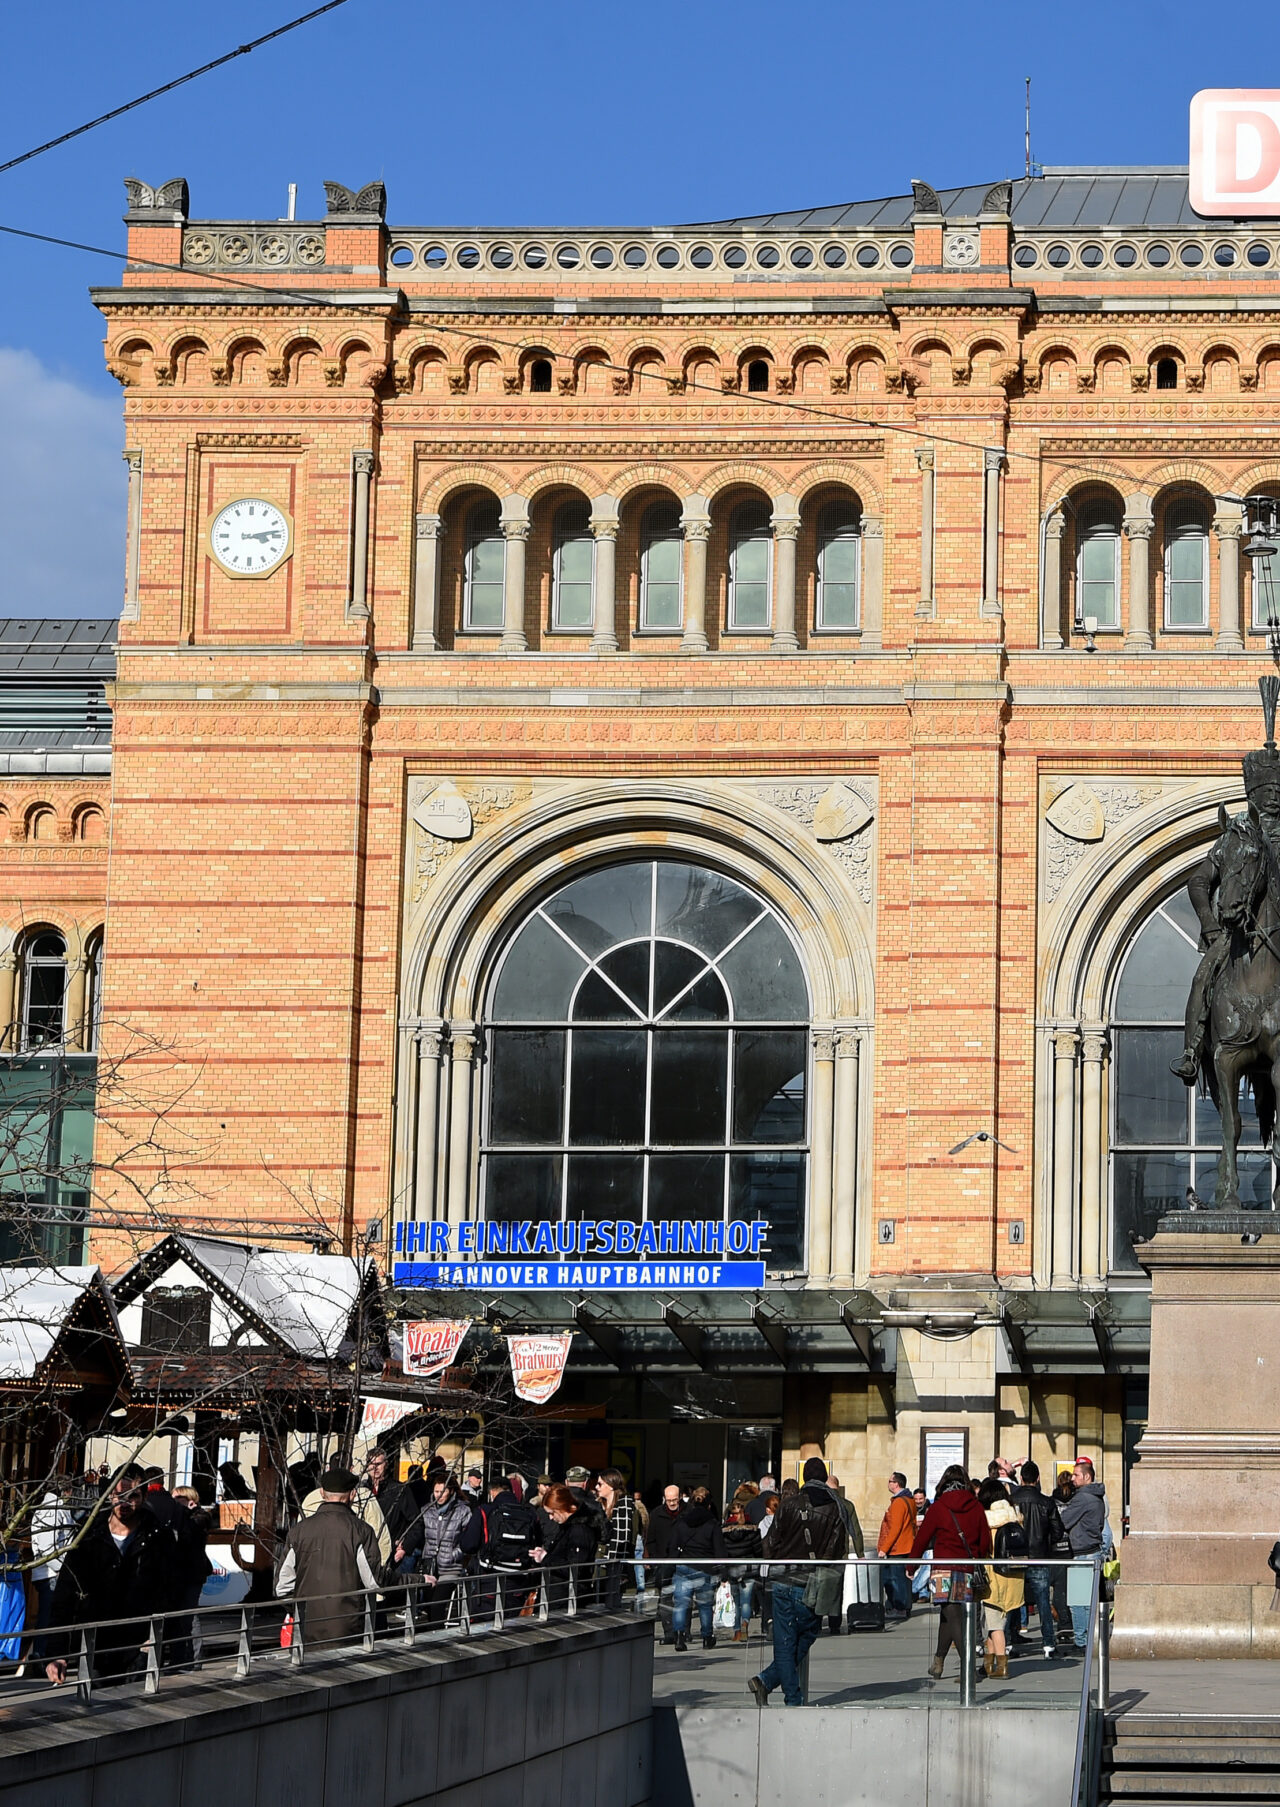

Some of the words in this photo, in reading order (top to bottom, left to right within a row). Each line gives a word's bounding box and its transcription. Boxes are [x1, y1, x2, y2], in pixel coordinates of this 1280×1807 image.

[394, 1220, 451, 1254] IHR
[457, 1220, 769, 1255] EINKAUFSBAHNHOF
[438, 1266, 549, 1285] HANNOVER
[556, 1266, 723, 1285] HAUPTBAHNHOF
[514, 1352, 566, 1370] Bratwurst
